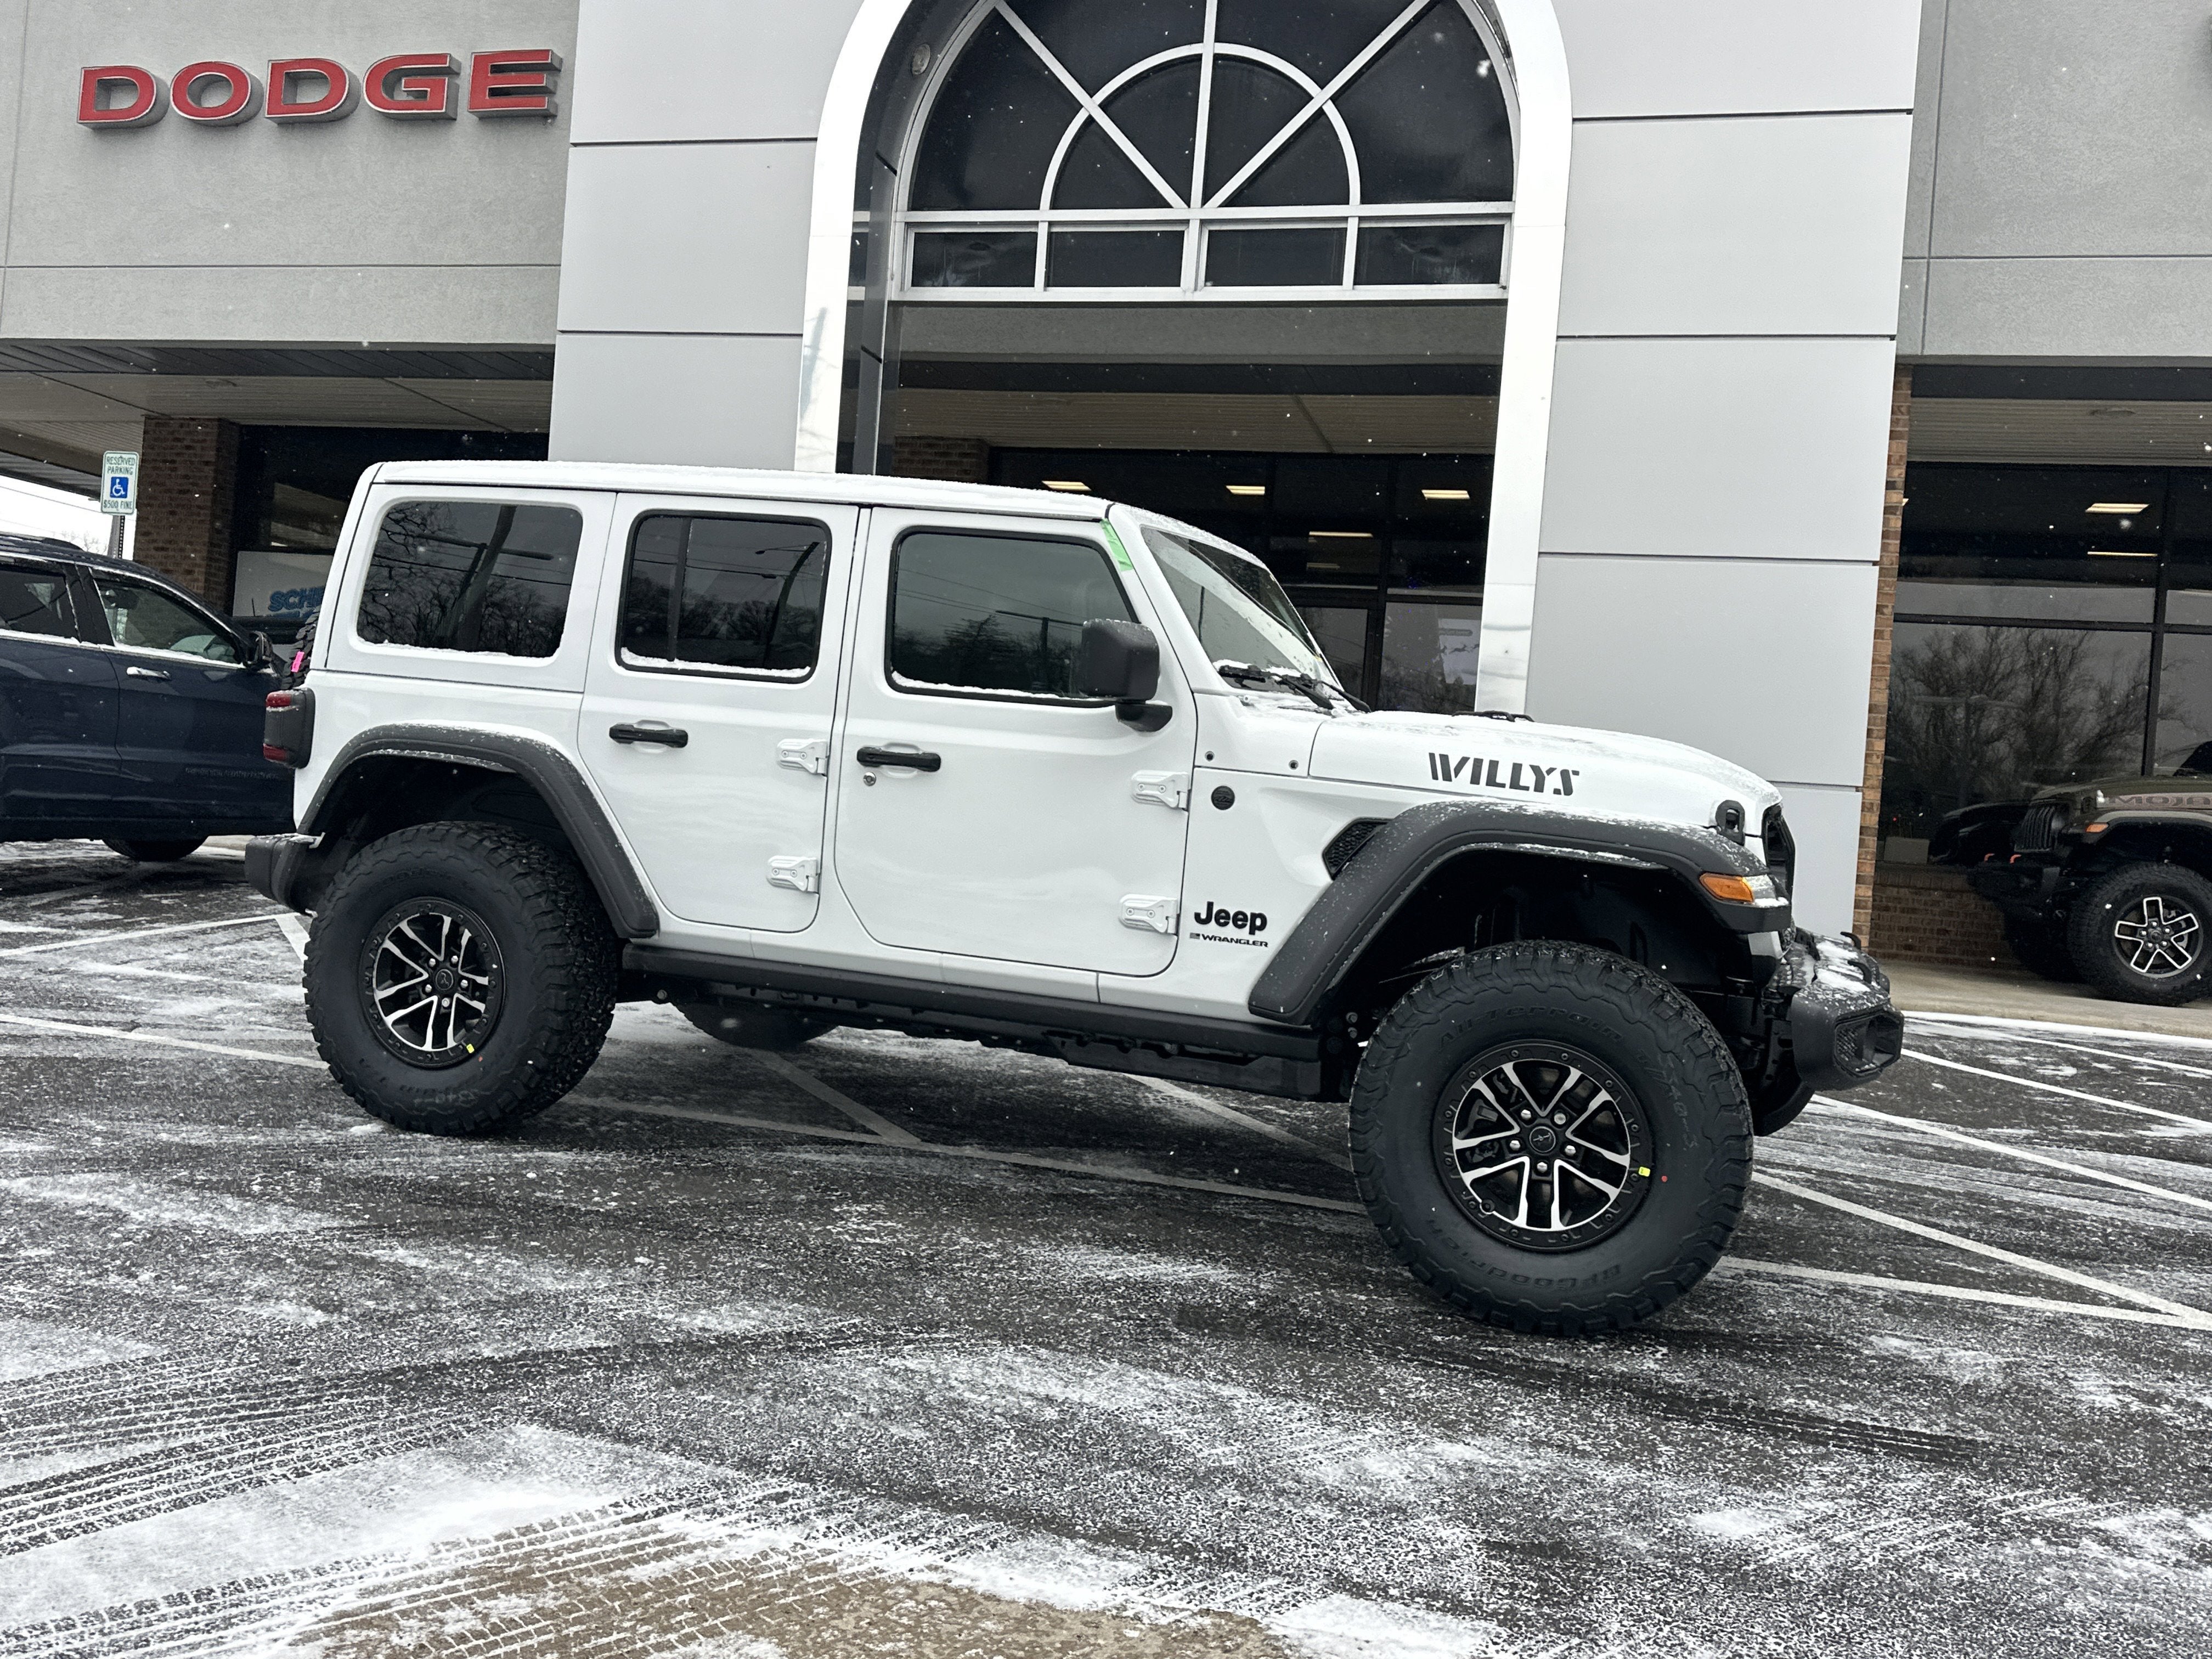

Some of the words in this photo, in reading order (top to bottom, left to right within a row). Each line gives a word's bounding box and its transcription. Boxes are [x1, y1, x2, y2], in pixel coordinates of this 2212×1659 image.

[78, 49, 561, 127] DODGE
[106, 456, 135, 466] RESERVED
[108, 466, 133, 475] PARKING
[104, 500, 119, 509] $500
[120, 500, 132, 509] FINE
[1429, 752, 1580, 796] WILLYS
[1194, 901, 1267, 935] Jeep
[1201, 934, 1268, 947] WRANGLER
